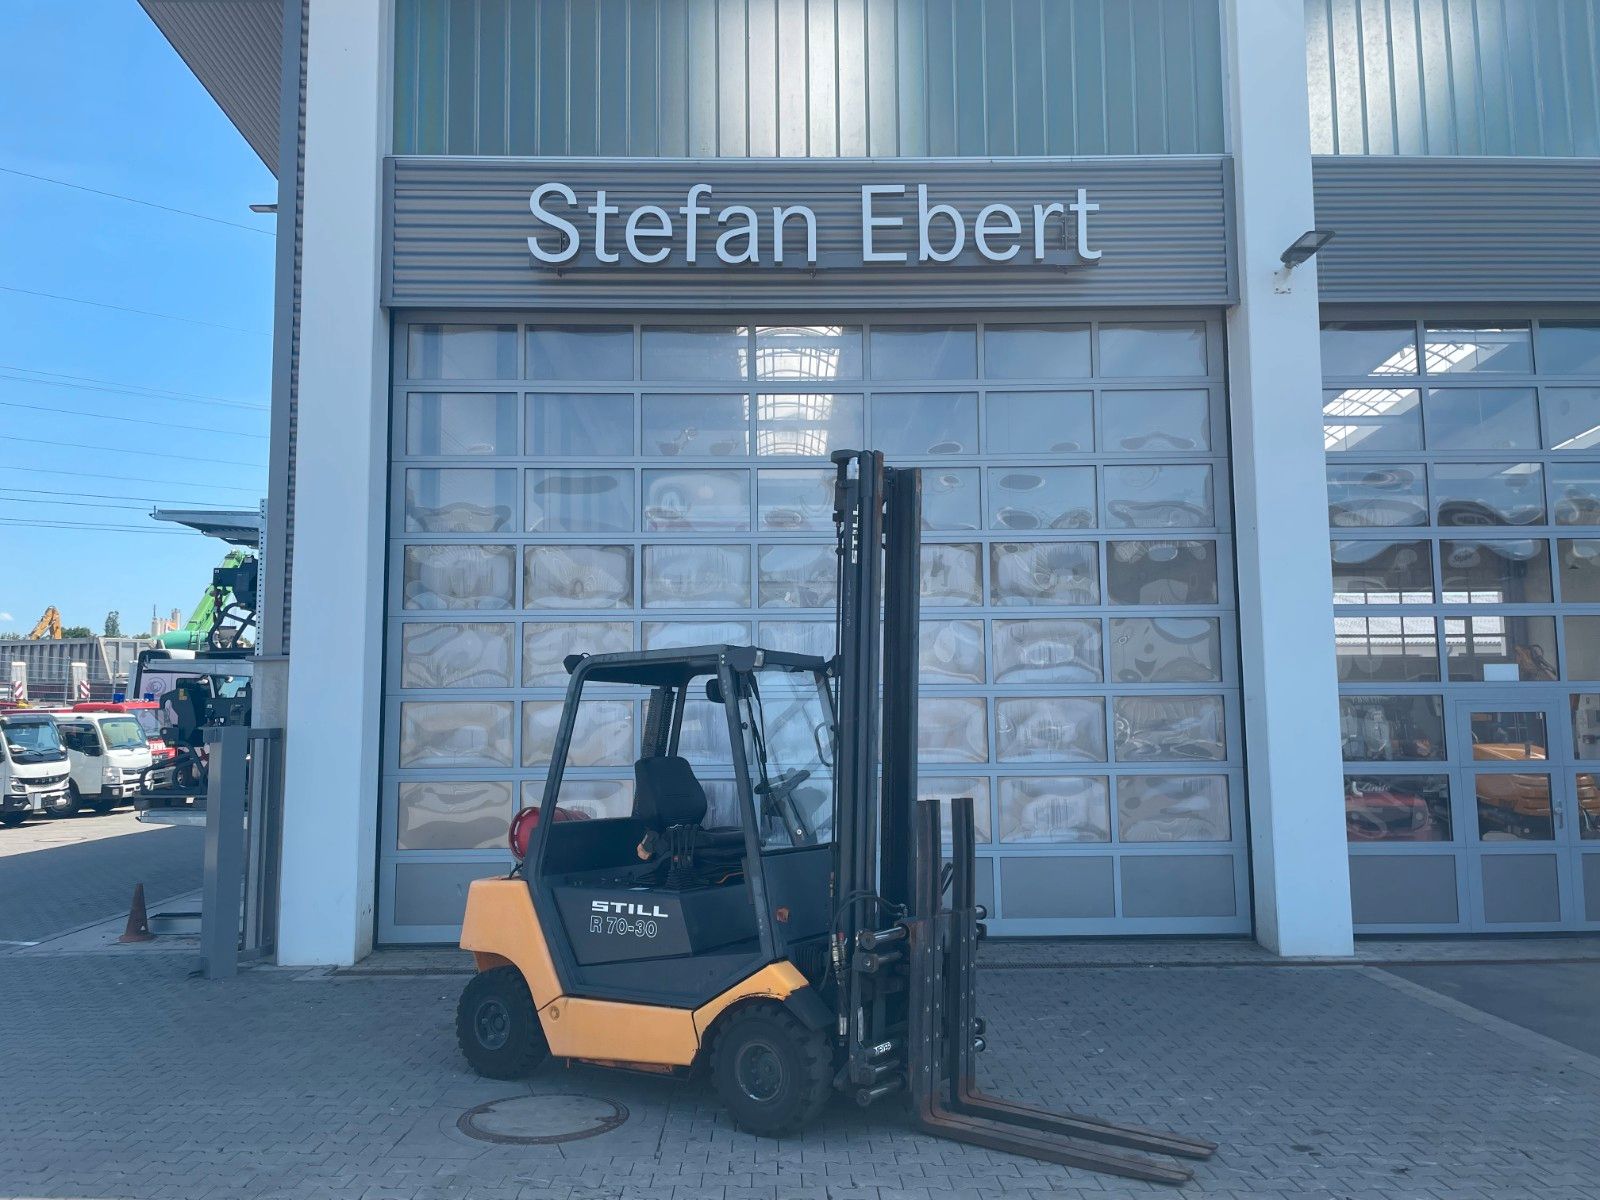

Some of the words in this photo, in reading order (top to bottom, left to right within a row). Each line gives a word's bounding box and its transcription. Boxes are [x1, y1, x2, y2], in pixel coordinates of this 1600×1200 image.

[527, 182, 818, 264] Stefan
[861, 183, 1102, 262] Ebert
[851, 504, 859, 564] STILL
[589, 915, 602, 933] R
[606, 916, 658, 938] 70-30
[591, 900, 669, 918] STILL
